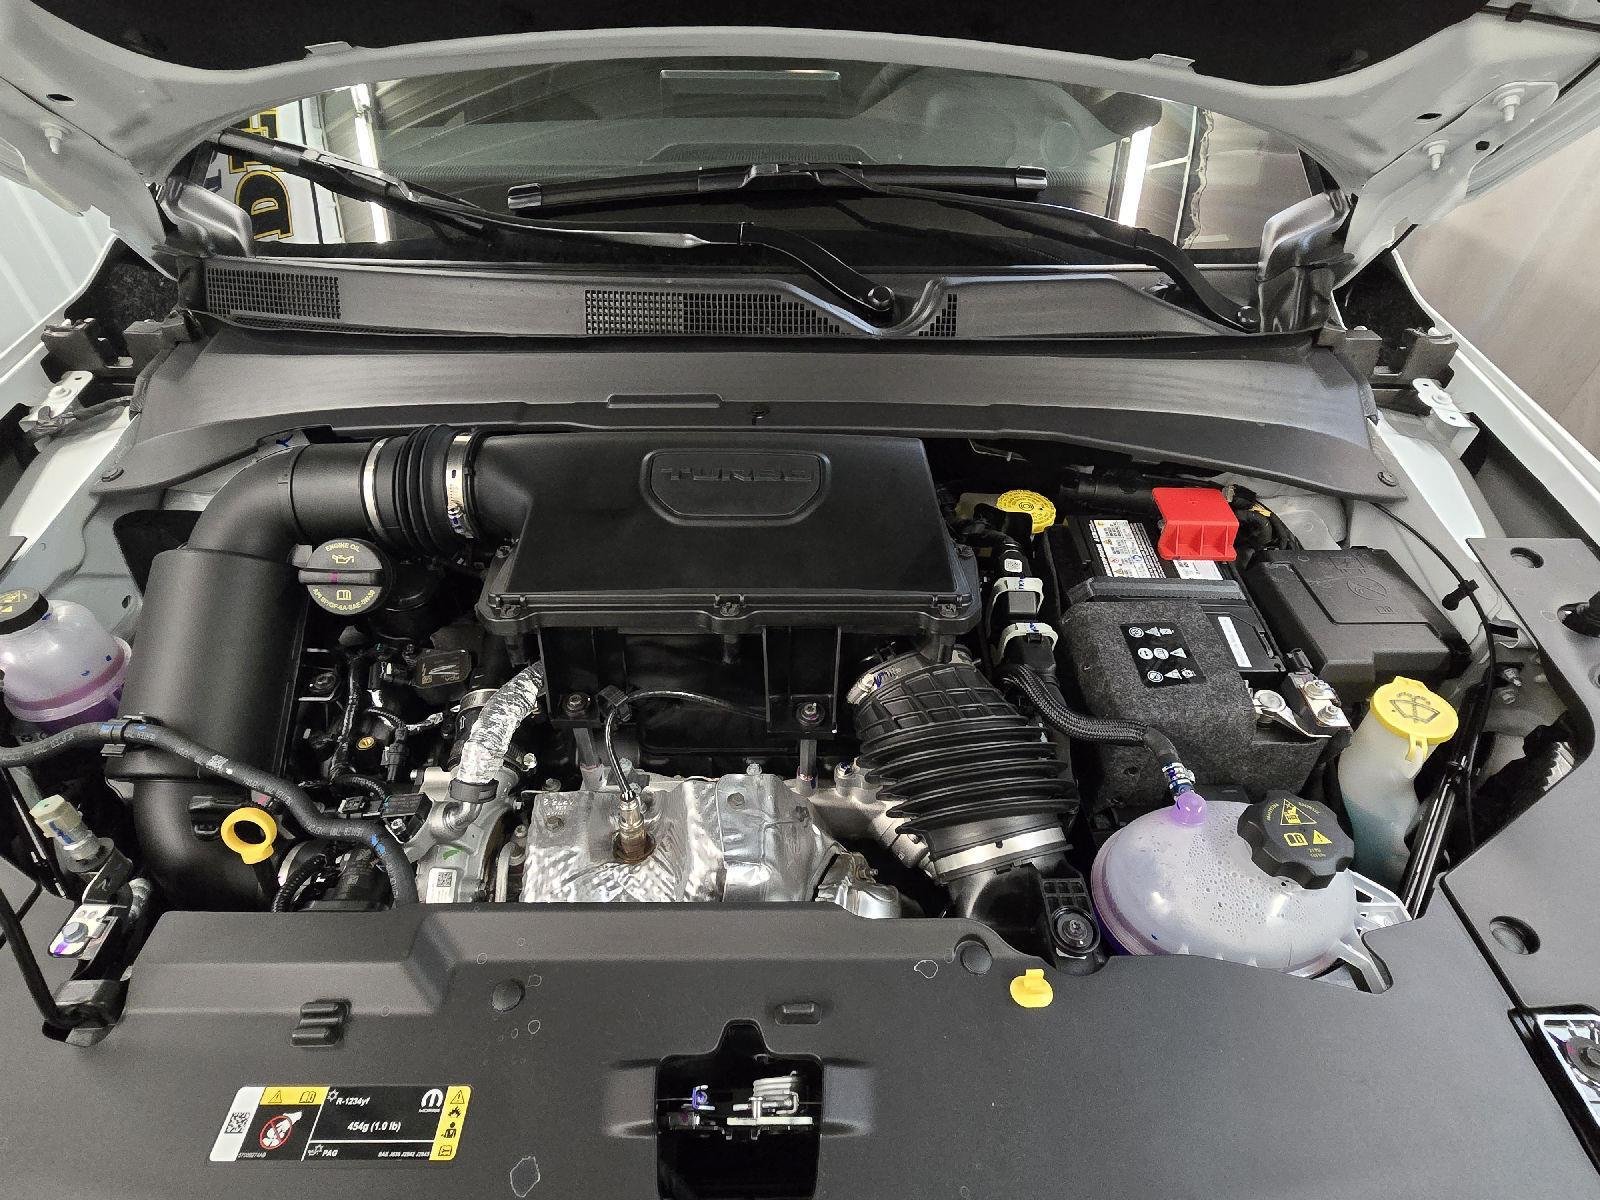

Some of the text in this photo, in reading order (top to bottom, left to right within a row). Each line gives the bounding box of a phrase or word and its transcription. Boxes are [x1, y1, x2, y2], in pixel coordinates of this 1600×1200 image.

[660, 465, 814, 483] TURBO
[325, 542, 361, 553] ENGINE OIL
[336, 1096, 371, 1107] R-1234yf
[347, 1121, 402, 1133] 454g (1.0 lb)
[322, 1149, 339, 1157] PAG
